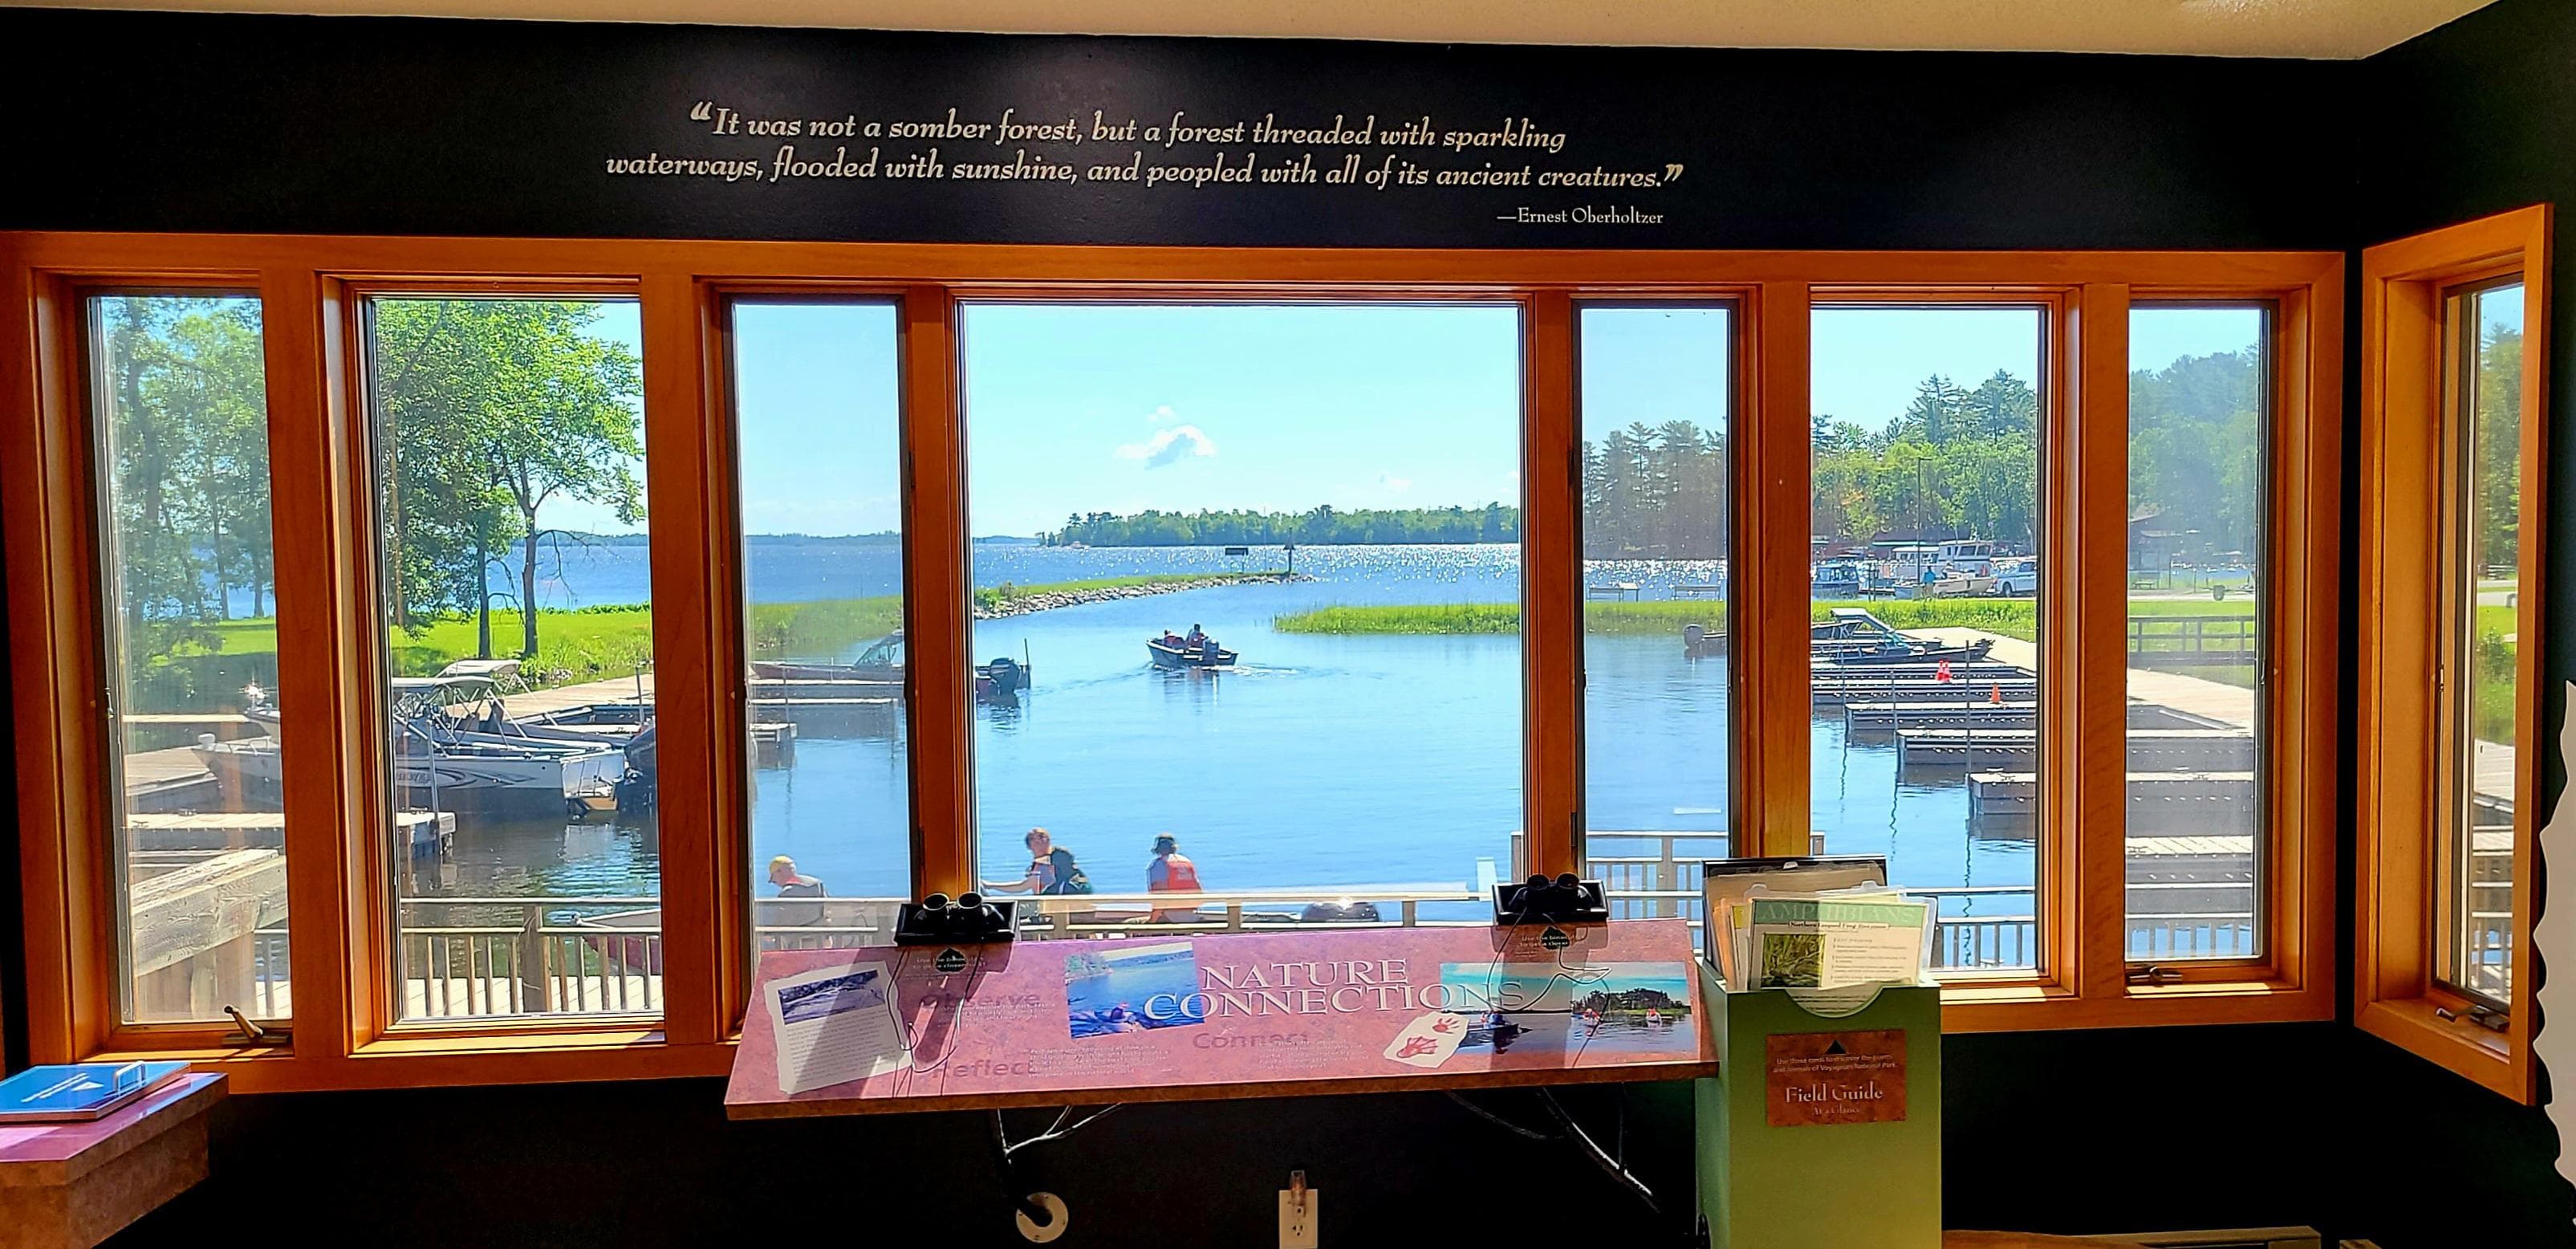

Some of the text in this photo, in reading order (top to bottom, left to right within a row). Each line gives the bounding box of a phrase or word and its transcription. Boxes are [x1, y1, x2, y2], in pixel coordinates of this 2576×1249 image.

[747, 120, 802, 136] was
[809, 115, 856, 137] not
[863, 121, 881, 137] a
[888, 108, 991, 140] somber
[996, 108, 1083, 146] forest,
[1091, 110, 1137, 141] but
[1144, 126, 1161, 142] a
[1166, 111, 1245, 148] forest
[1253, 113, 1375, 145] threaded
[1379, 116, 1436, 147] with
[1442, 117, 1566, 153] sparkling
[606, 153, 763, 182] waterways,
[769, 145, 879, 183] flooded
[884, 148, 945, 179] with
[952, 149, 1078, 185] sunshine,
[1087, 151, 1142, 182] and
[1146, 152, 1255, 189] peopled
[1261, 154, 1317, 184] with
[1325, 154, 1361, 185] all
[1365, 154, 1397, 191] of
[1398, 161, 1429, 185] its
[1436, 162, 1531, 187] ancient
[1571, 205, 1664, 225] Oberholtzer
[1201, 958, 1408, 991] NATURE
[1143, 978, 1527, 1021] CONNECTIONS
[1785, 1080, 1884, 1103] Field Guide
